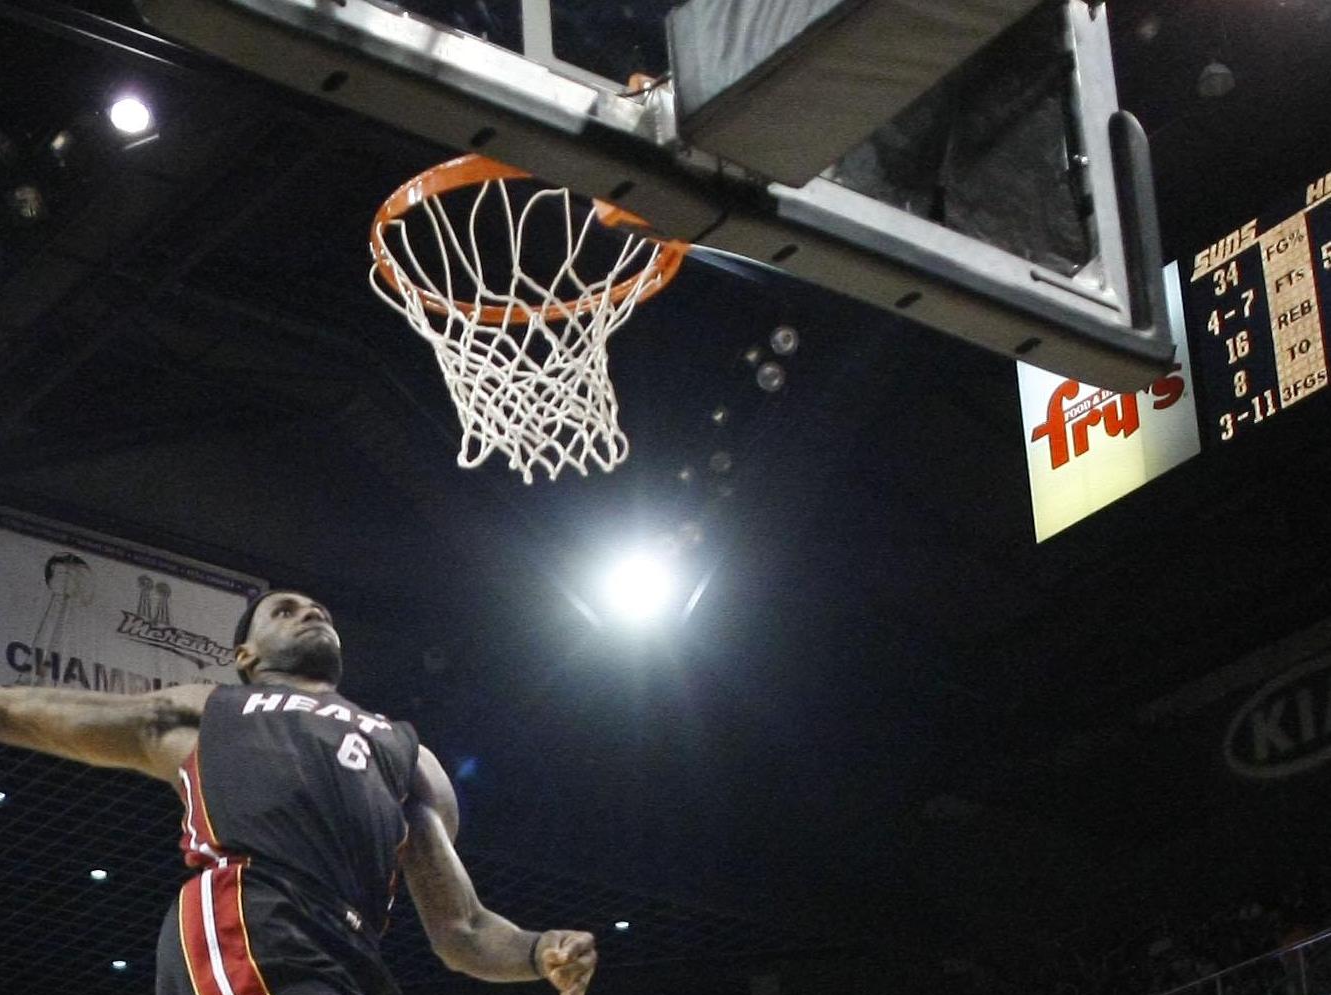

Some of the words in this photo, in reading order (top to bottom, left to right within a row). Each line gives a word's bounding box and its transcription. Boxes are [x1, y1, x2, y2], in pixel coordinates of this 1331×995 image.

[1192, 218, 1258, 276] SUNS
[1265, 229, 1305, 263] FG%
[1212, 260, 1239, 296] 34
[1277, 299, 1314, 330] REB
[1225, 330, 1250, 365] 16
[1286, 339, 1312, 362] TO
[1233, 369, 1248, 399] 8
[6, 641, 179, 694] CHAMPI
[242, 692, 393, 734] HEAT
[336, 732, 372, 771] 6
